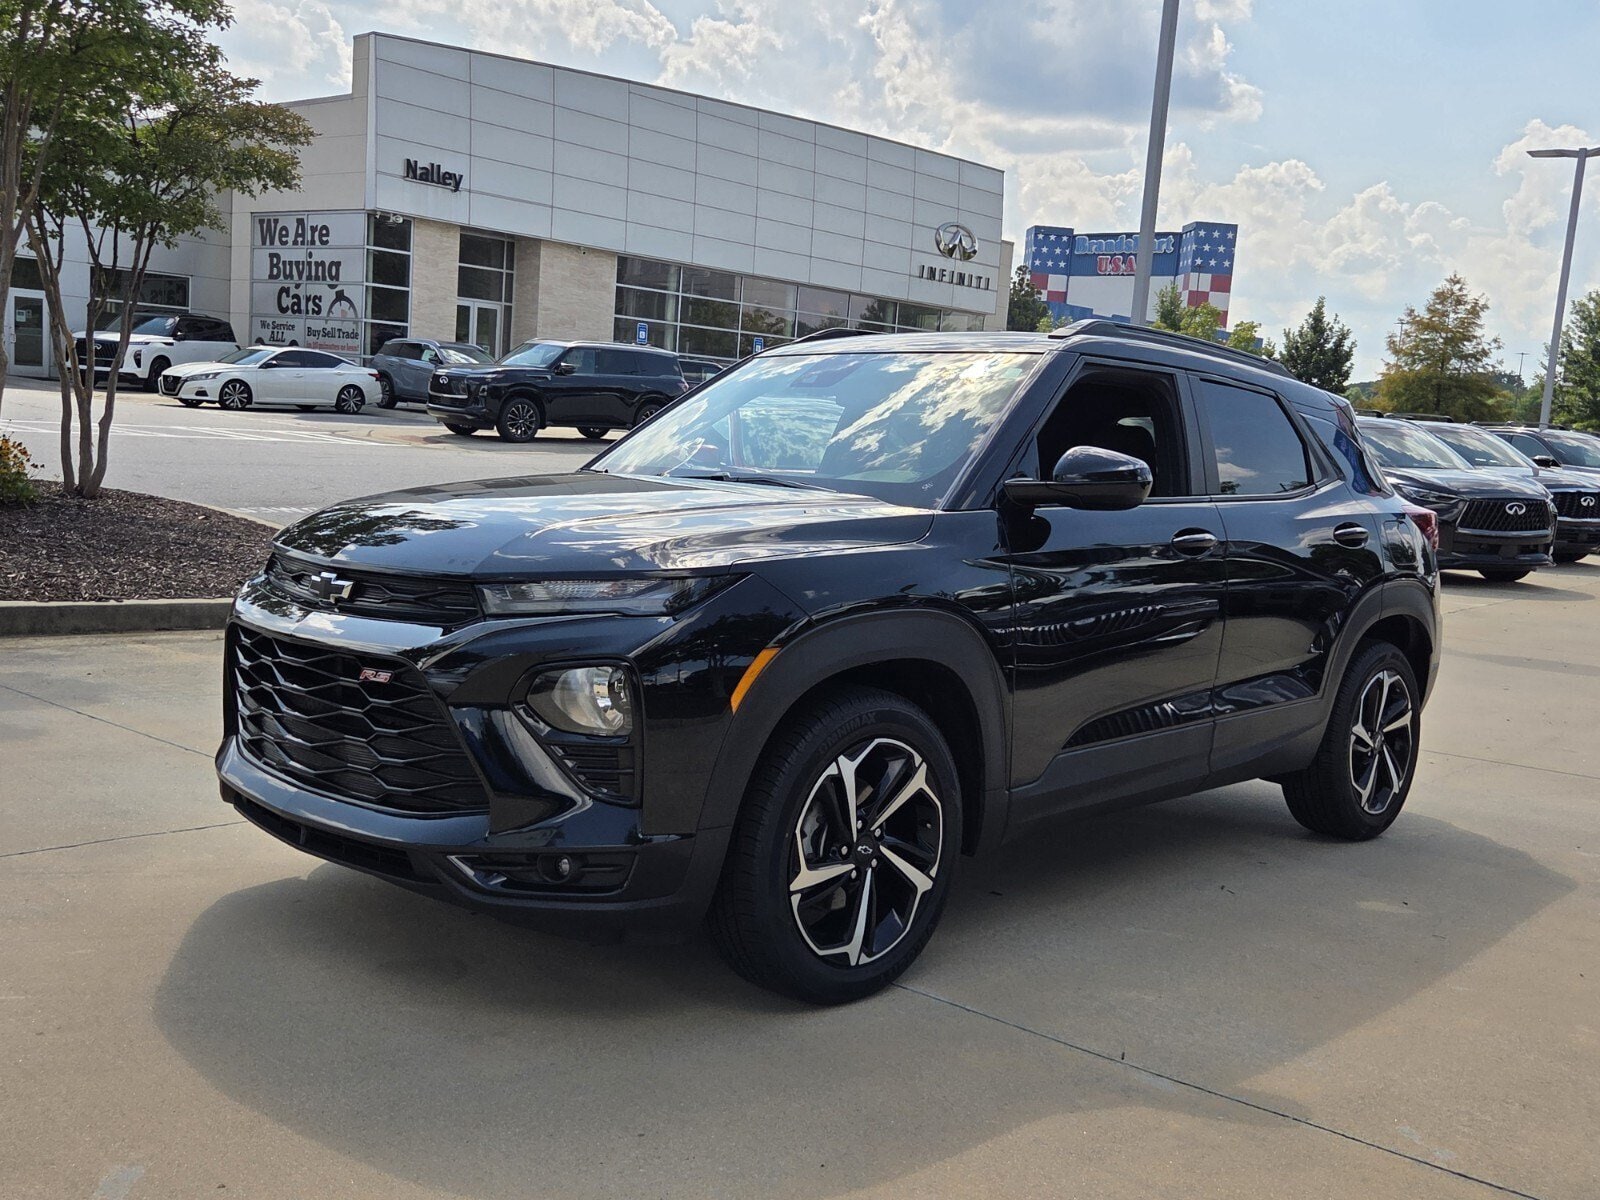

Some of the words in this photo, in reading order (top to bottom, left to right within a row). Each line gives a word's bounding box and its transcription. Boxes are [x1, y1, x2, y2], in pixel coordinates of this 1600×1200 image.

[404, 158, 463, 192] Nalley
[258, 218, 290, 246] We
[292, 217, 330, 246] Are
[268, 251, 342, 290] Buying
[918, 264, 990, 290] INFINITI
[277, 285, 322, 316] Cars
[260, 320, 271, 330] We
[271, 320, 296, 331] Service
[269, 331, 286, 343] ALL
[306, 326, 321, 340] Buy
[321, 327, 336, 339] Sell
[336, 328, 359, 340] Trade
[359, 668, 392, 683] RS
